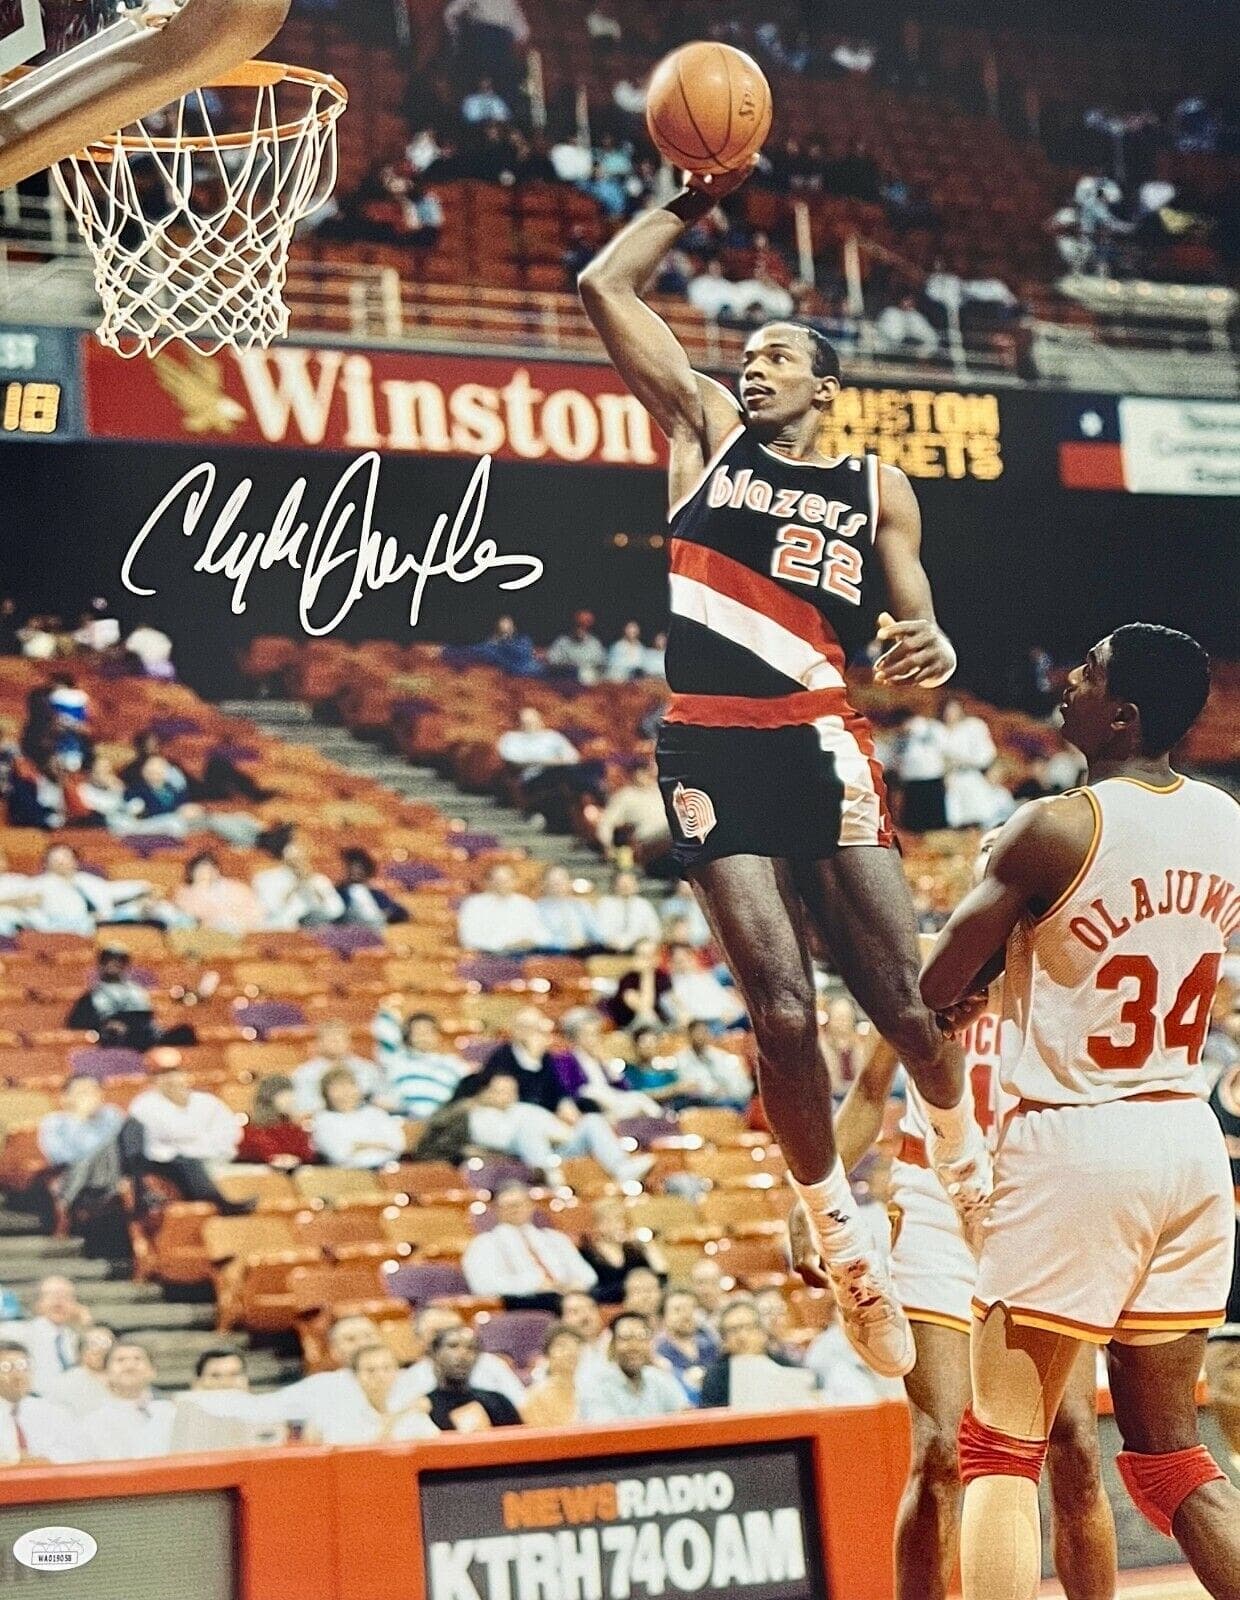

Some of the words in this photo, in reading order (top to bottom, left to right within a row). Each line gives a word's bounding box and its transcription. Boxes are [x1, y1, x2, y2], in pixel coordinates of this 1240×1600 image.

[234, 348, 658, 464] Winston
[707, 464, 869, 538] blazers
[770, 522, 864, 606] 22
[1086, 951, 1222, 1070] 34
